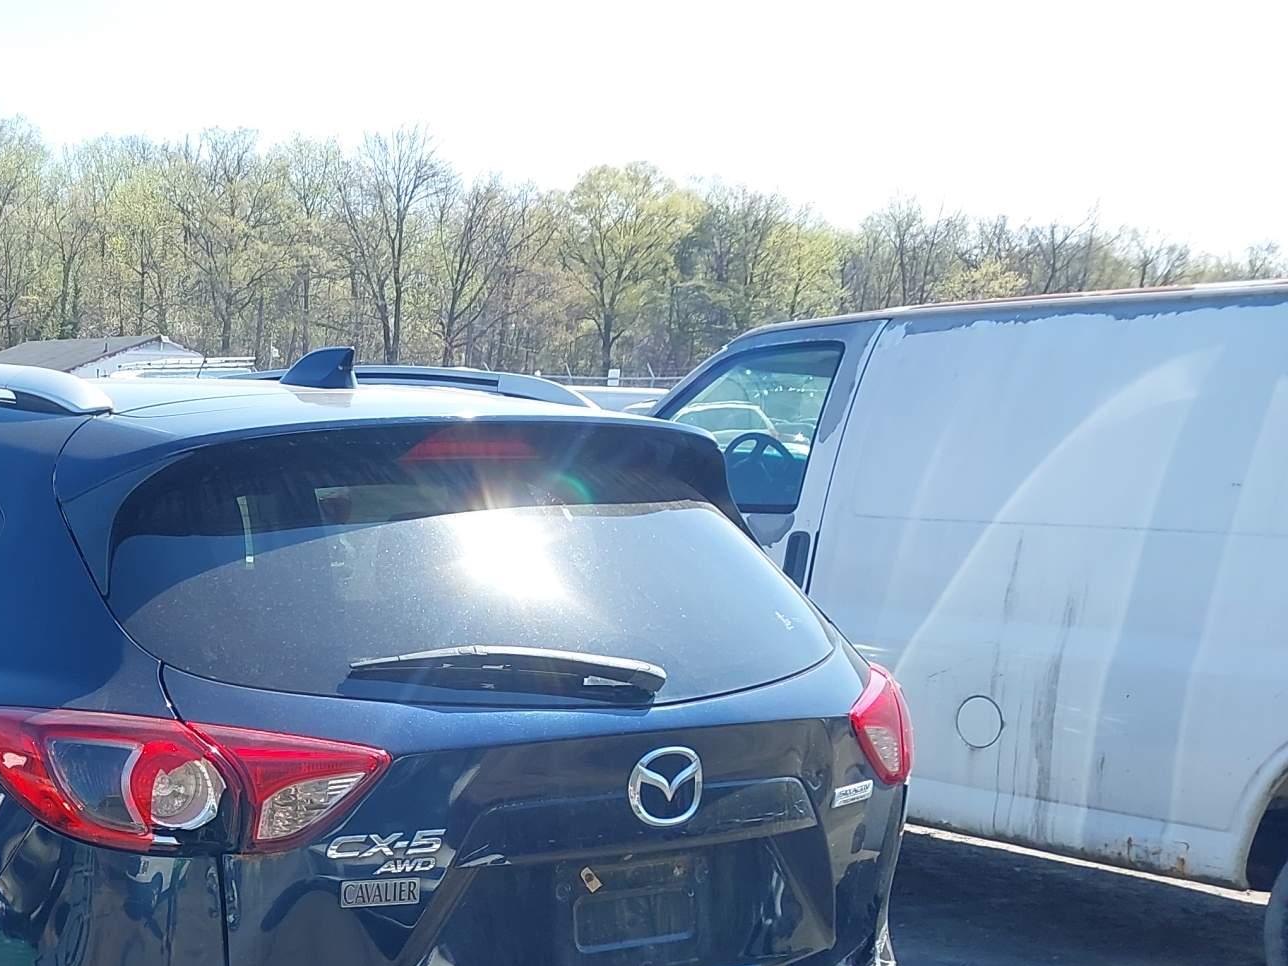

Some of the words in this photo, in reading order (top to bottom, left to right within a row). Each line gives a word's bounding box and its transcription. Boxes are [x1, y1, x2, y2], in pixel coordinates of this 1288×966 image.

[326, 828, 447, 859] CX-5
[372, 857, 436, 876] AWD
[343, 881, 417, 905] CAVALIER
